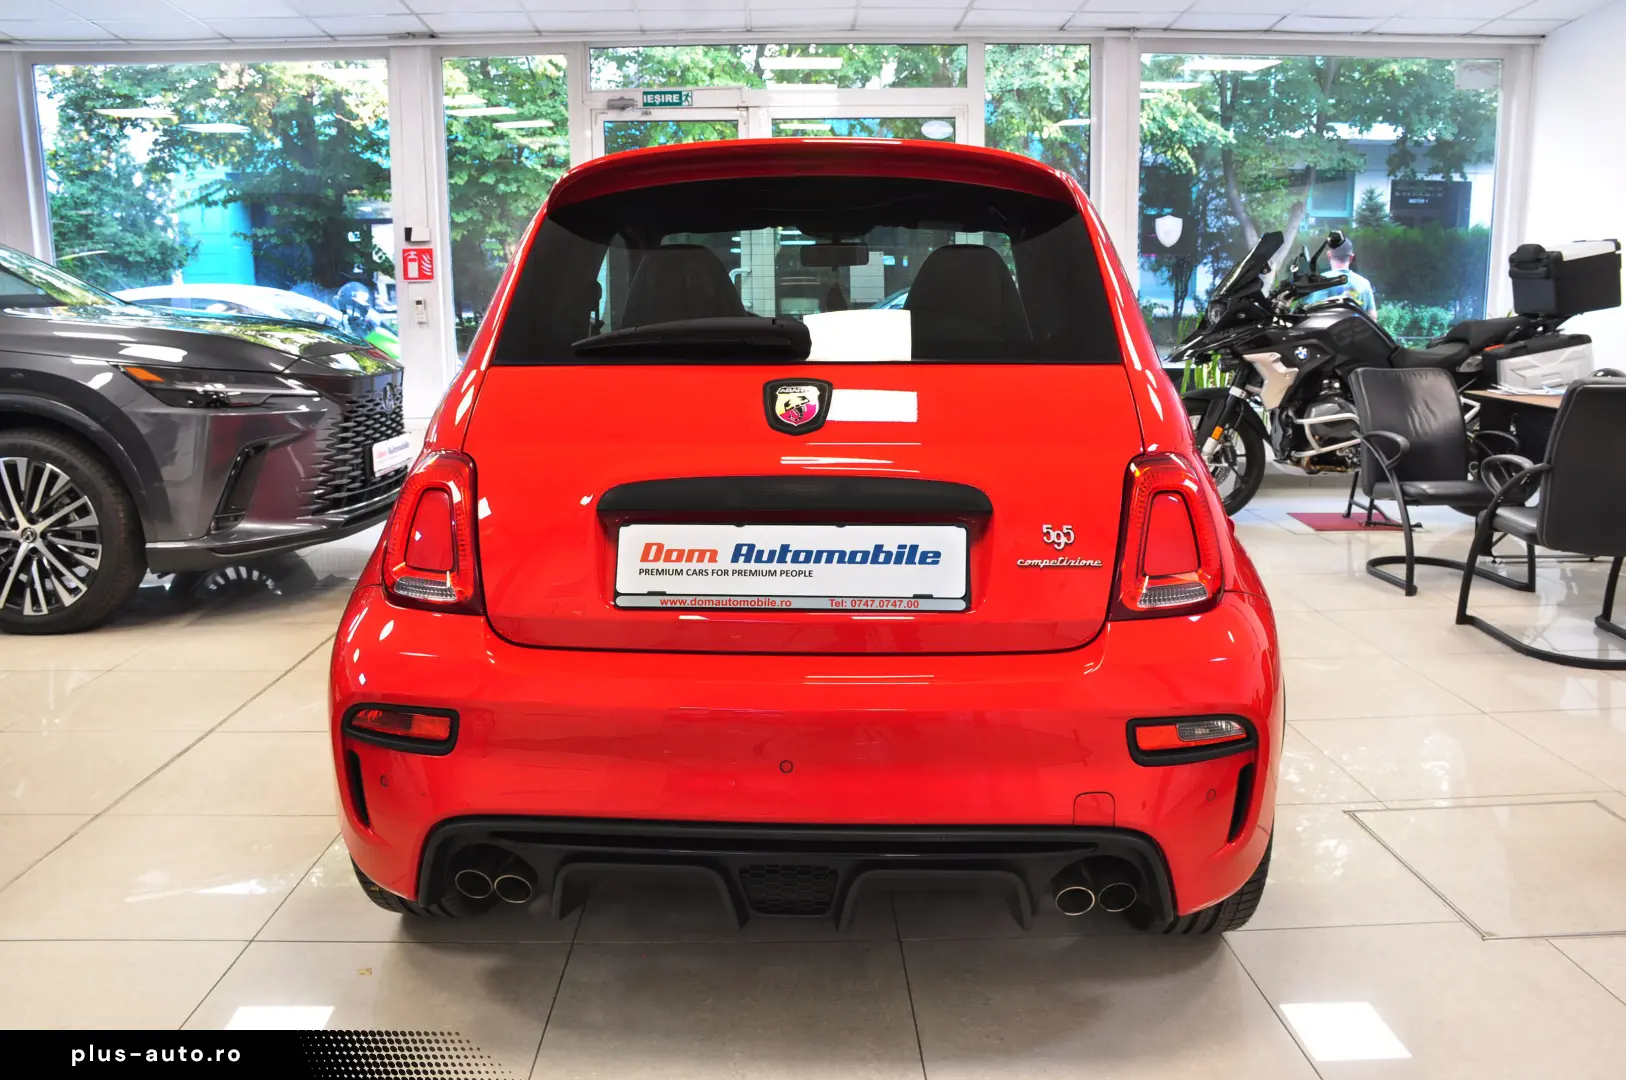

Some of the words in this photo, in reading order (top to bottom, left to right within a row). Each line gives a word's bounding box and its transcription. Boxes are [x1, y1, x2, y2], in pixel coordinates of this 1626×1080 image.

[1042, 524, 1075, 550] 595
[640, 542, 719, 564] Dom
[730, 543, 942, 566] Automobile
[1016, 556, 1103, 568] competizione
[638, 568, 684, 577] PREMIUM
[685, 569, 709, 577] CARS
[711, 569, 730, 577] FOR
[731, 569, 778, 578] PREMIUM
[779, 570, 814, 578] PEOPLE
[659, 598, 792, 608] www.domautomobile.ro
[828, 598, 848, 609] Tel:
[850, 599, 920, 609] 0747.0747.00
